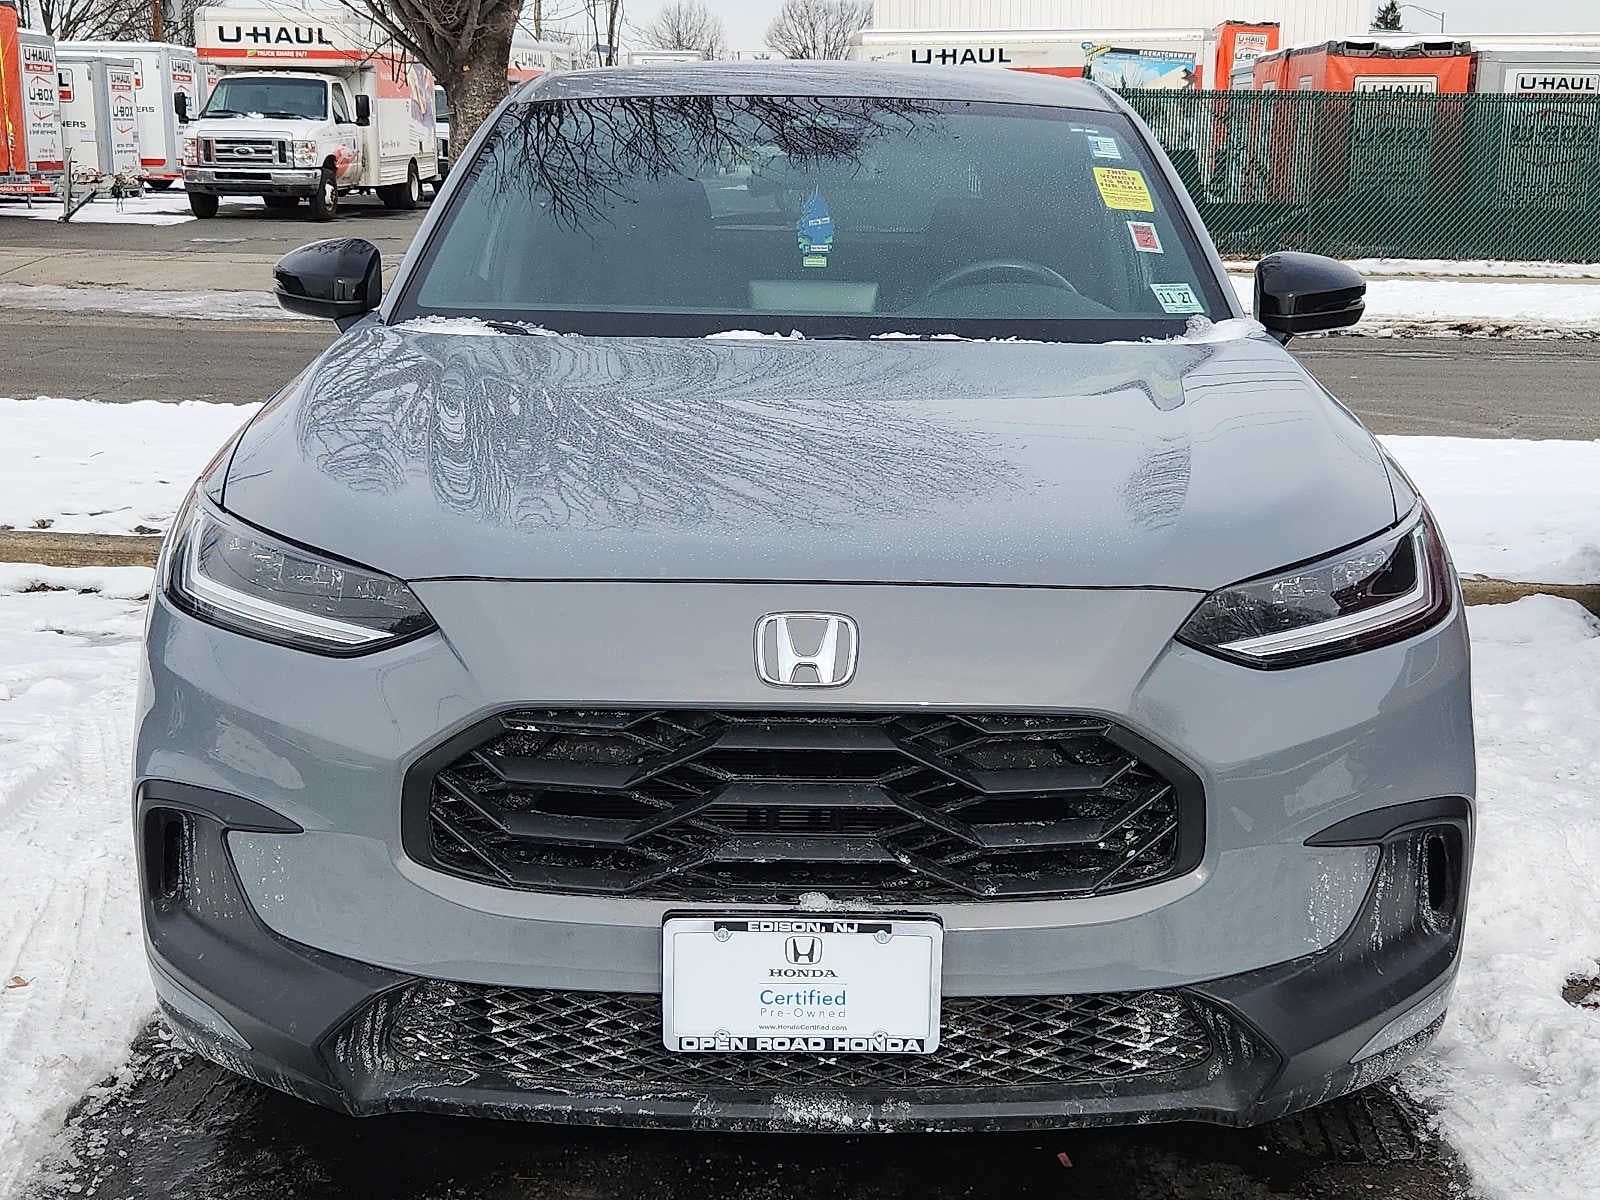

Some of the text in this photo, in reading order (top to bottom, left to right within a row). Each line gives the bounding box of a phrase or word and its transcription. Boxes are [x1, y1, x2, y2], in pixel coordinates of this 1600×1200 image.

[218, 25, 333, 45] U-HAUL
[24, 48, 53, 63] U-HAUL
[911, 47, 1012, 65] U-HAUL
[1520, 76, 1595, 91] U-HAUL
[28, 87, 54, 102] U-BOX
[112, 105, 134, 117] U-BOX
[1158, 291, 1193, 304] 11 27
[747, 921, 859, 933] EDISON, NJ
[768, 968, 839, 978] HONDA
[760, 989, 846, 1006] Certified
[760, 1007, 846, 1018] Pre-Owned
[758, 1023, 848, 1032] www.HondaCertified.com
[681, 1036, 925, 1053] OPEN ROAD HONDA
